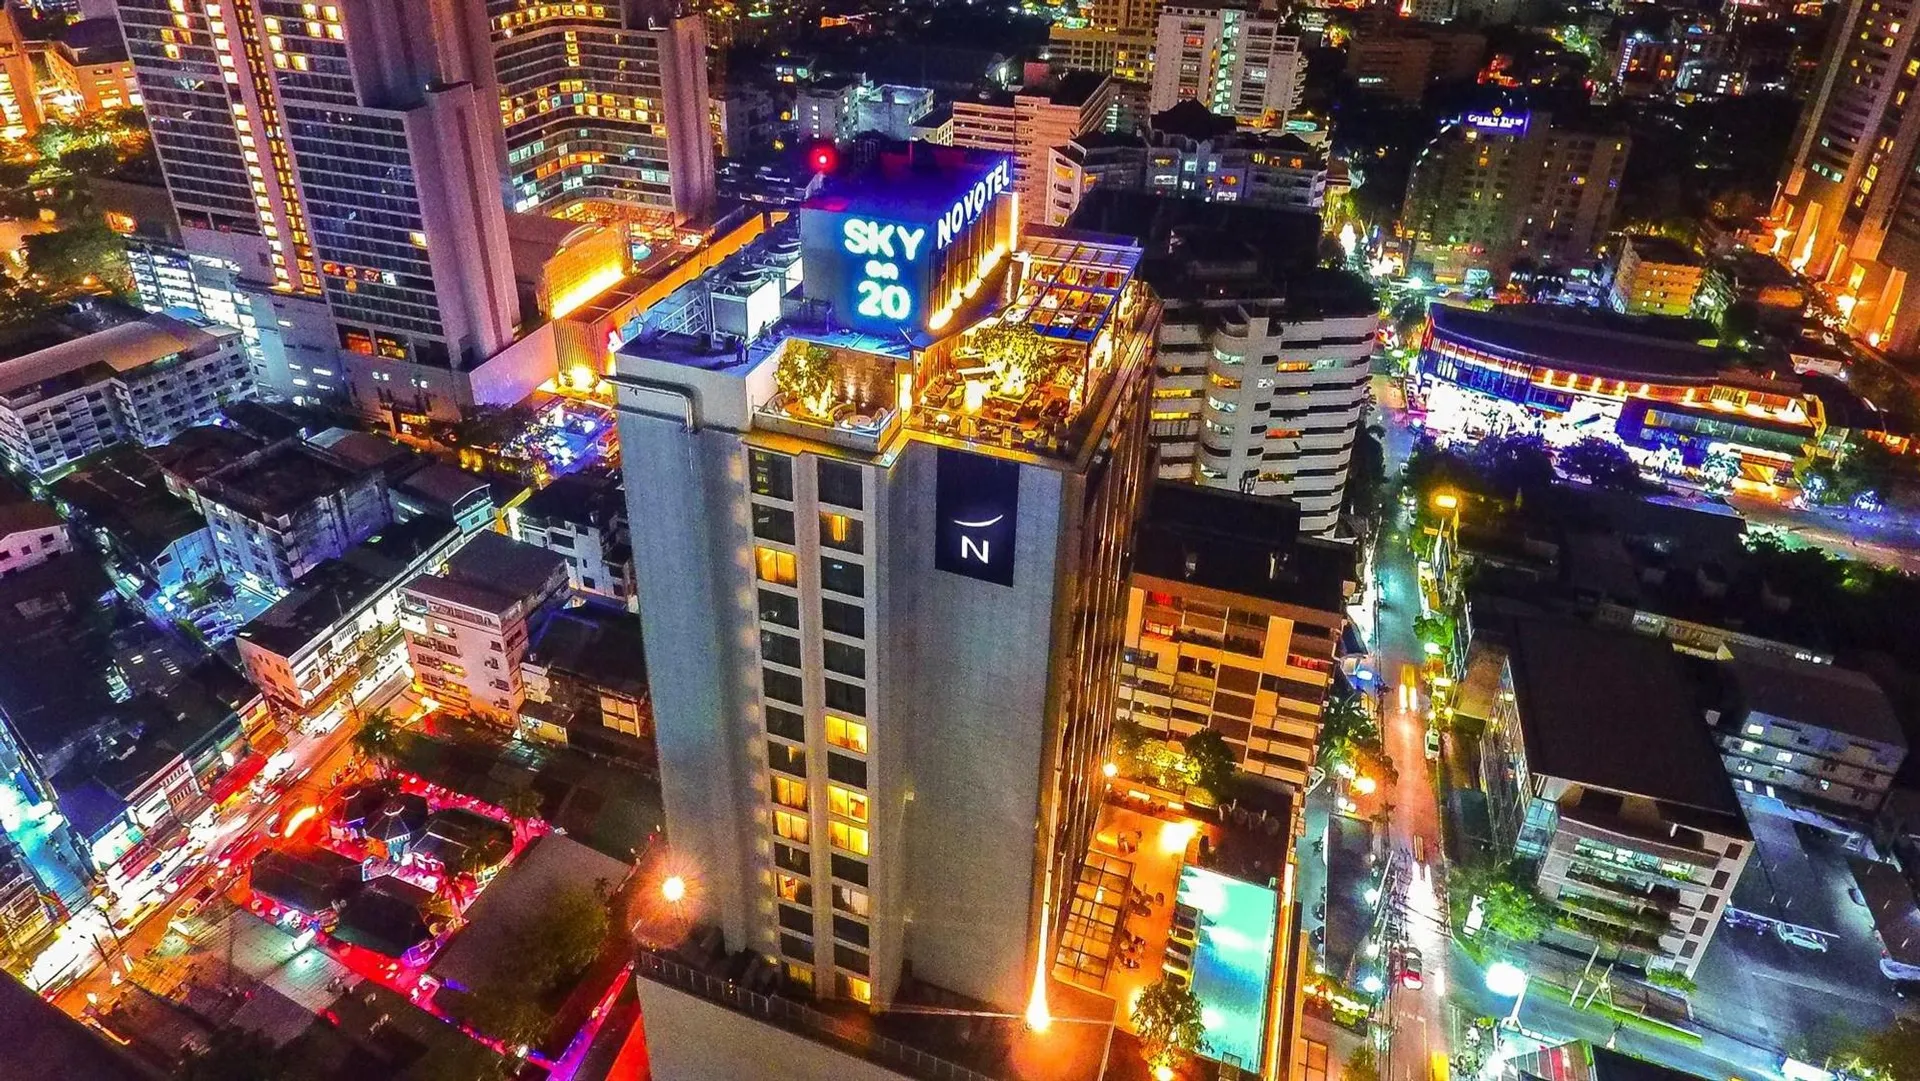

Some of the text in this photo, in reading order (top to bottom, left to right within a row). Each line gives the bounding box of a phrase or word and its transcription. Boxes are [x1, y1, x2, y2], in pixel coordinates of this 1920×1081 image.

[937, 159, 1010, 249] NOVOTEL
[843, 218, 926, 261] SKY
[857, 280, 912, 320] 20
[961, 534, 989, 565] N
